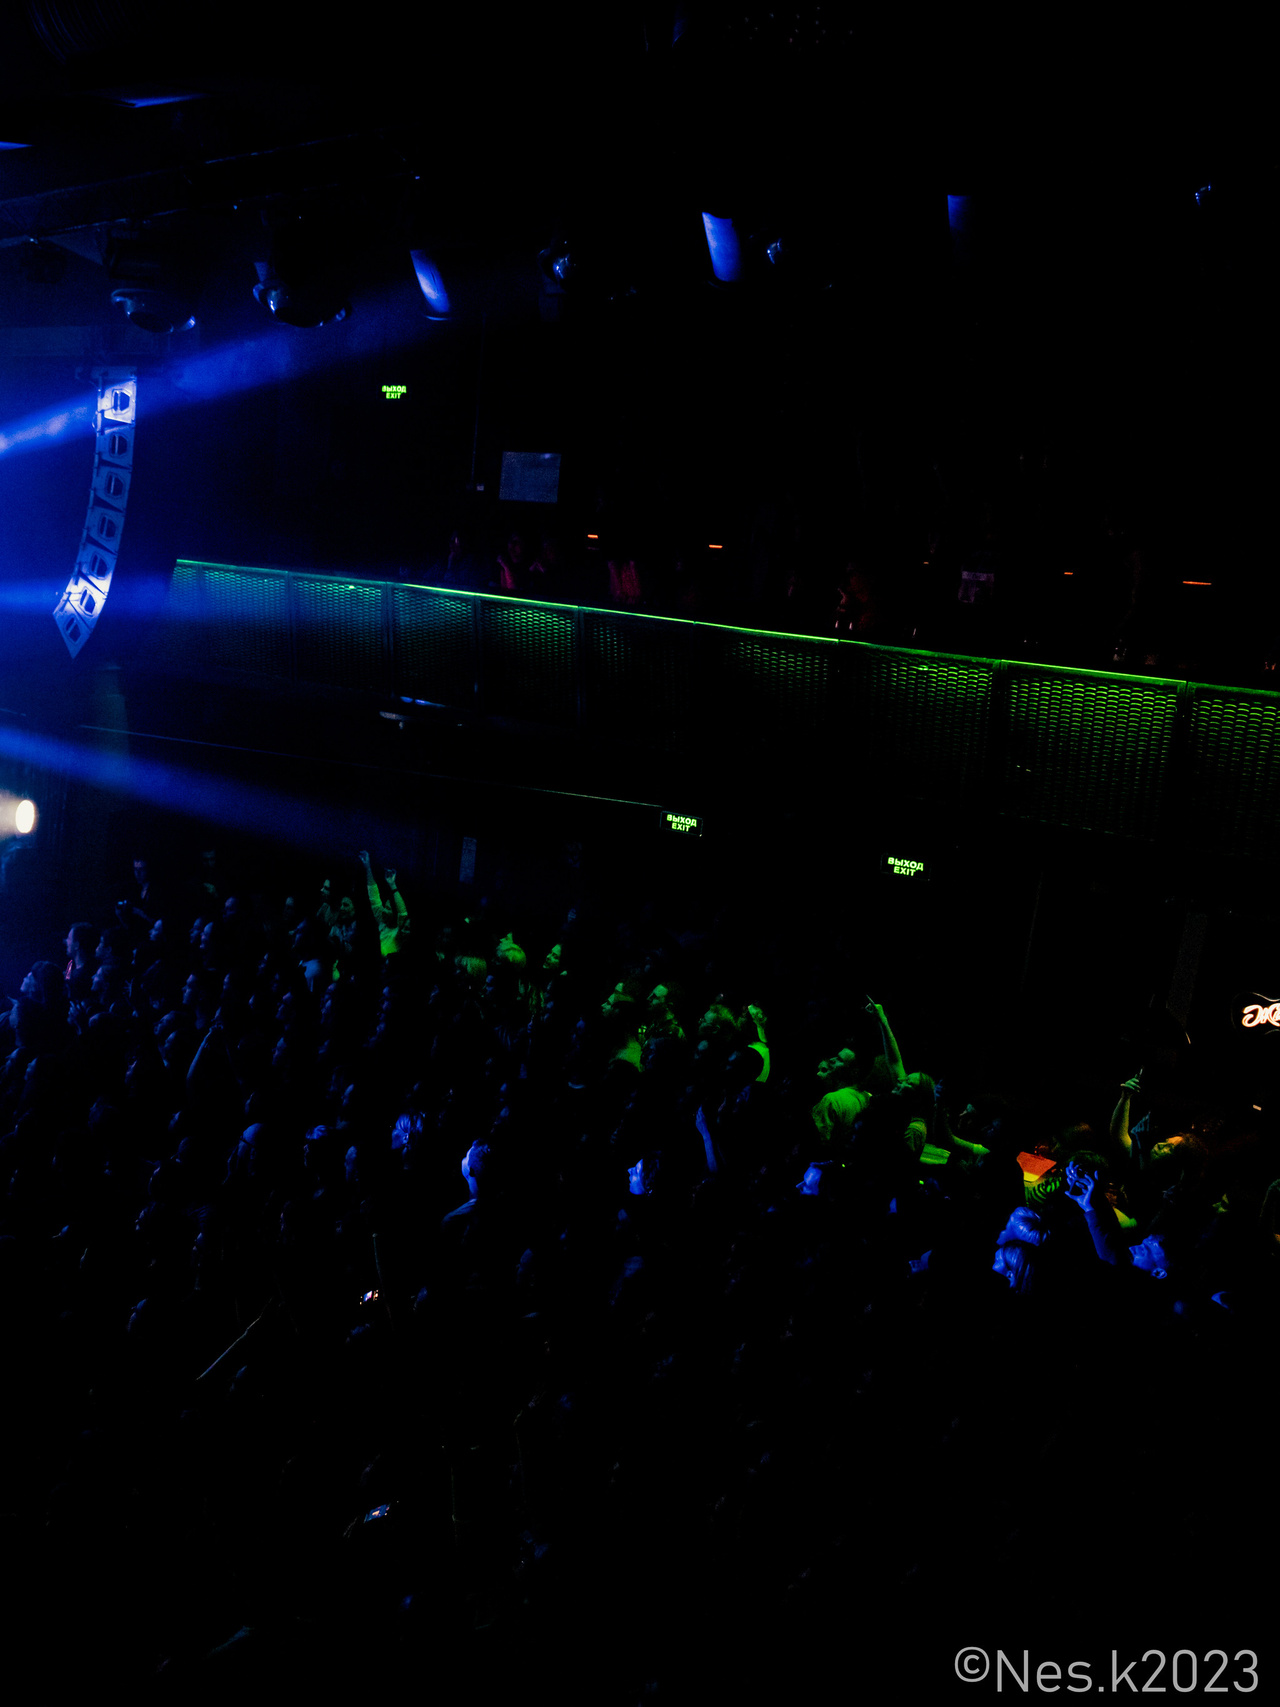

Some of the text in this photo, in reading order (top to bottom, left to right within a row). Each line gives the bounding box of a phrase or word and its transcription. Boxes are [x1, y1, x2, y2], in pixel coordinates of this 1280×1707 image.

[381, 385, 407, 393] ВЫХОД
[666, 814, 697, 827] ВЫХОД
[671, 822, 690, 832] EXIT
[887, 857, 924, 871] ВЫХОД
[893, 866, 916, 877] EXIT
